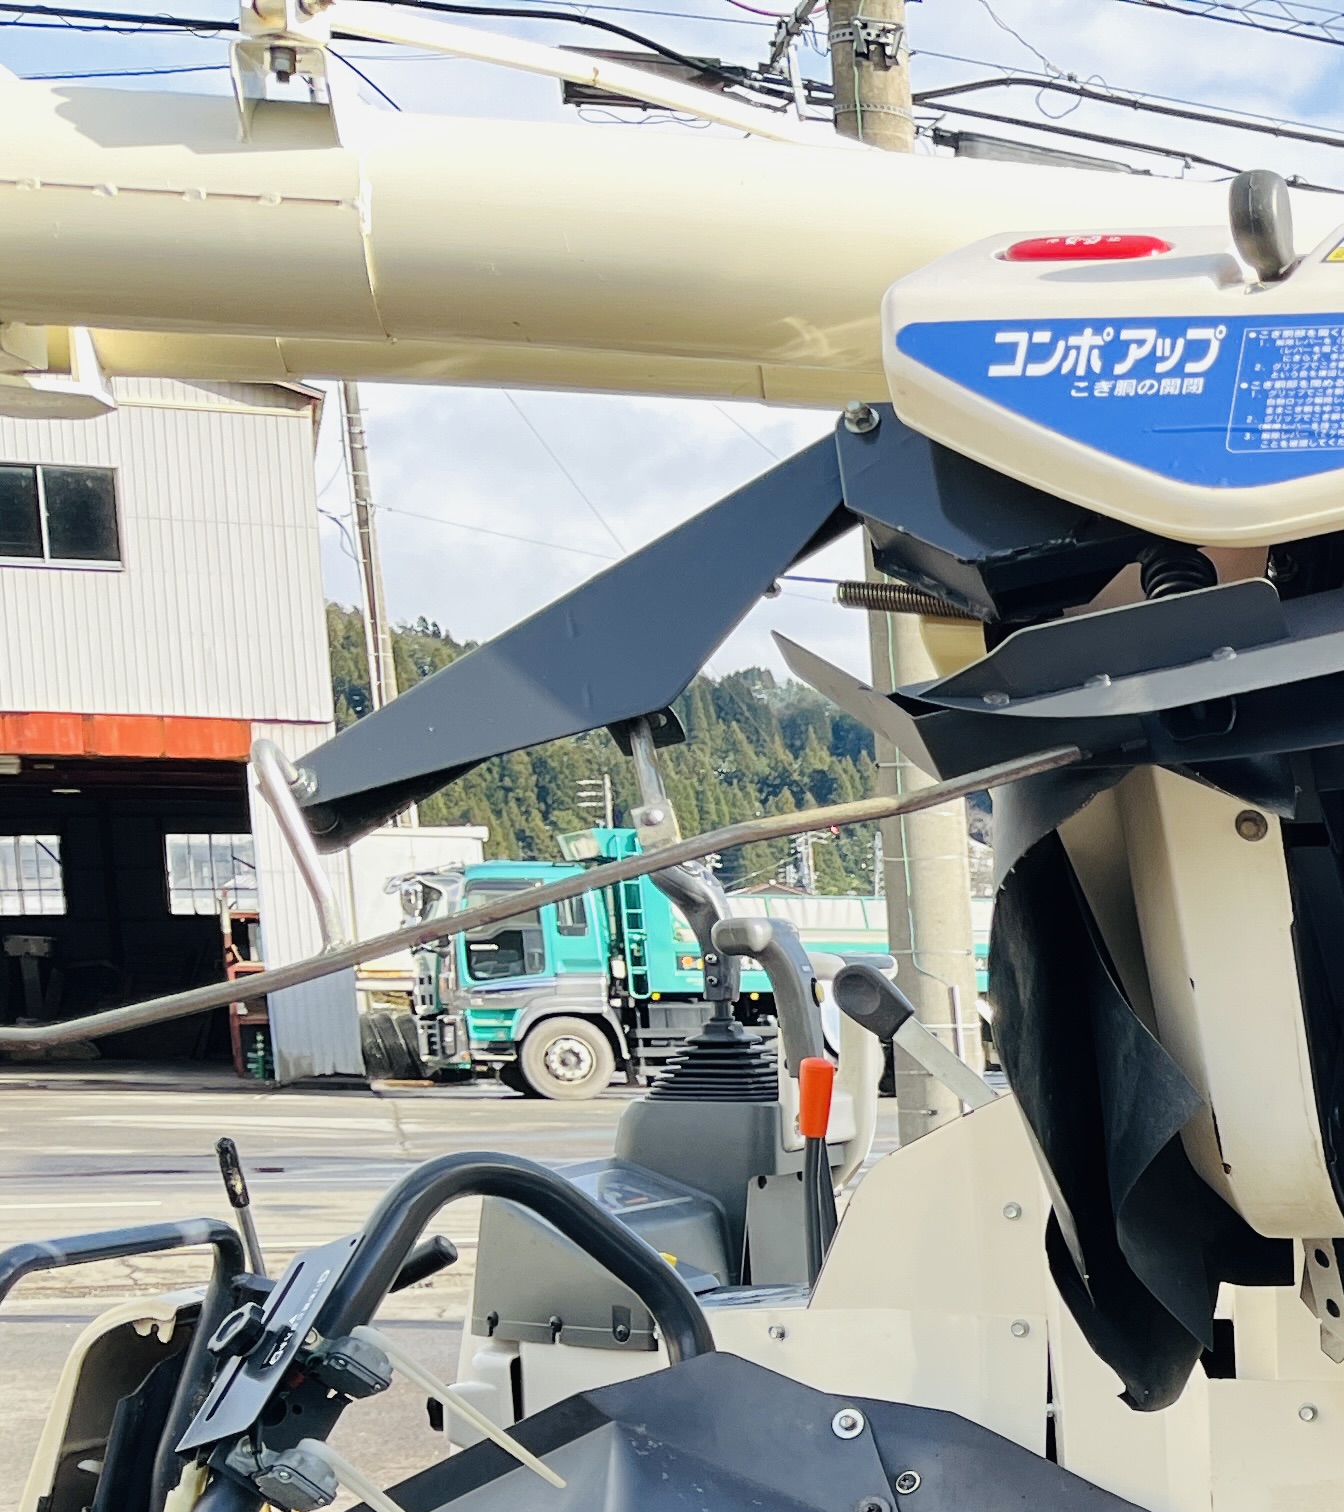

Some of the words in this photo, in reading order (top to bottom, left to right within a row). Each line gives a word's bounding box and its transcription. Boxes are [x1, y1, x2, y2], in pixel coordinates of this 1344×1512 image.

[987, 325, 1227, 377] コンポアップ
